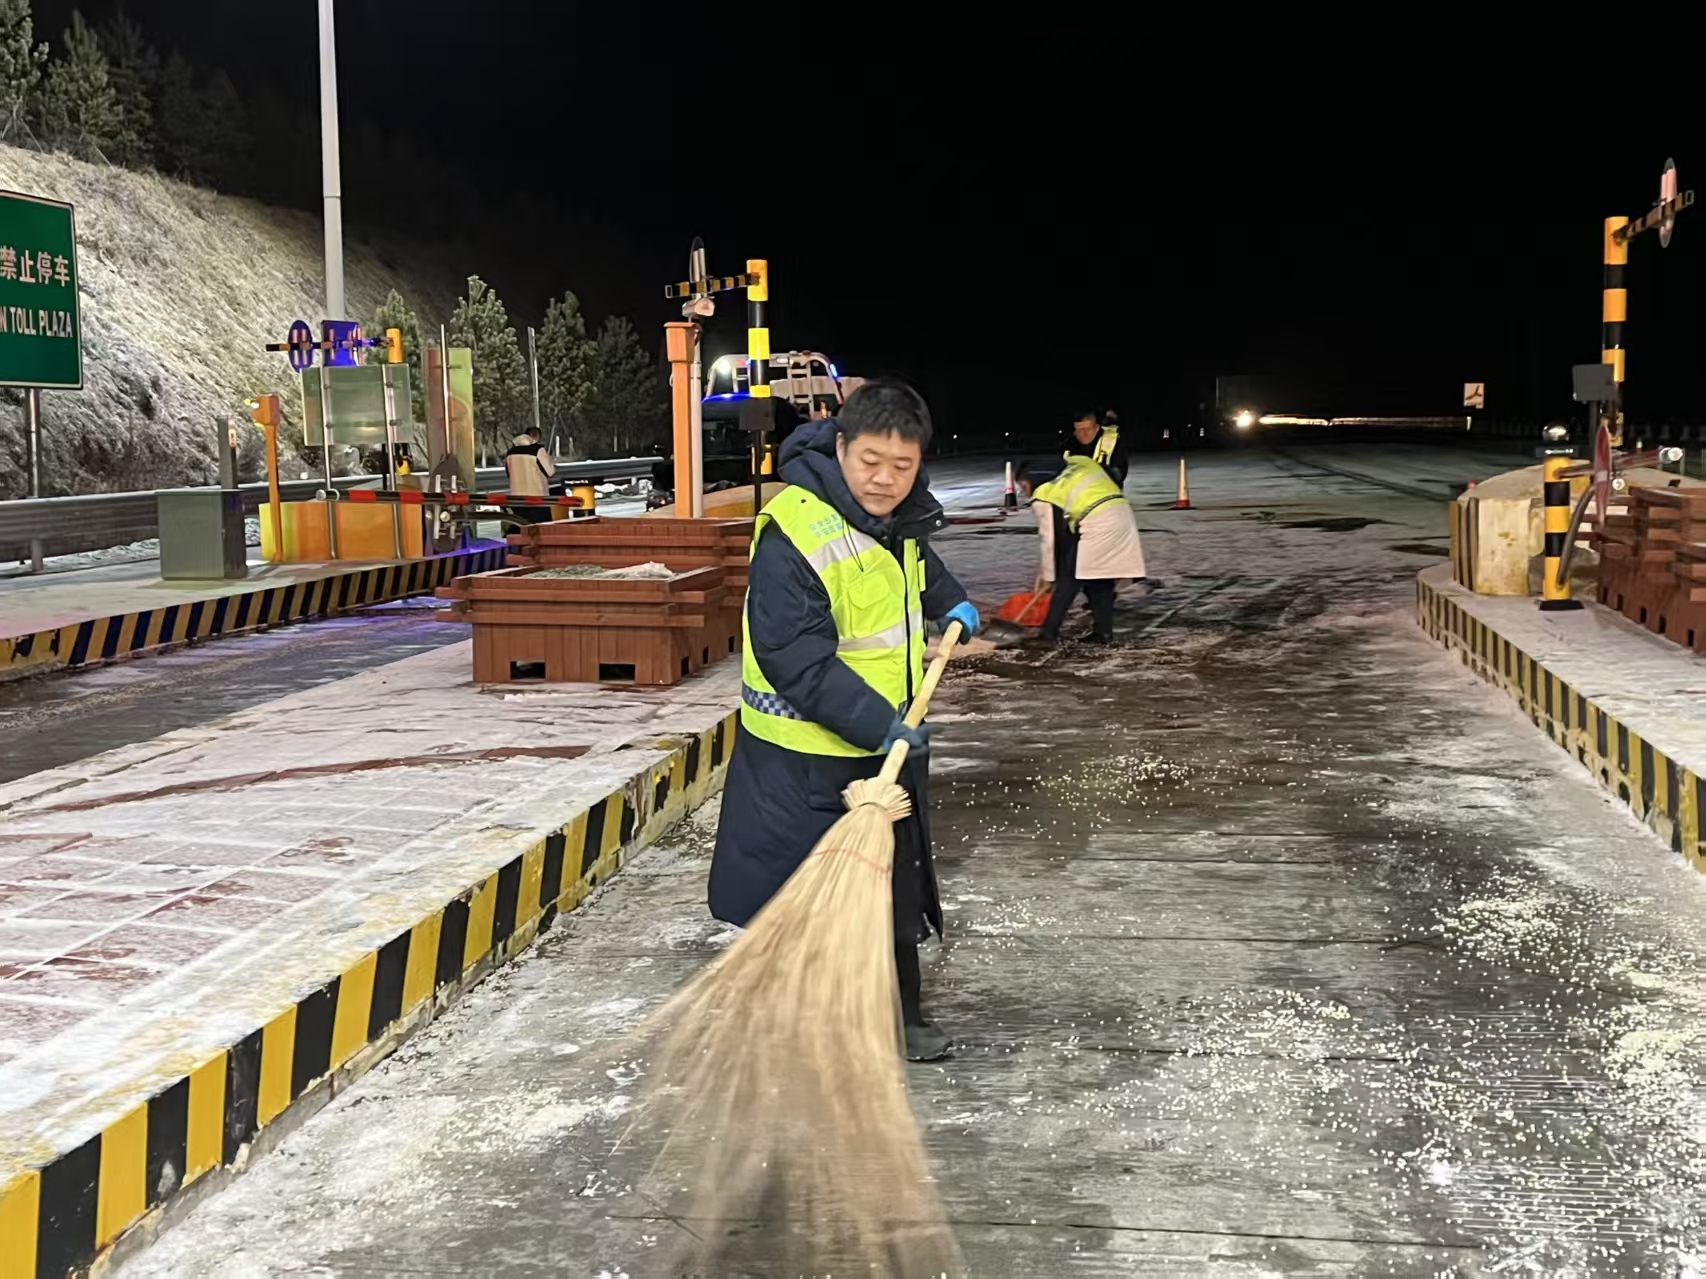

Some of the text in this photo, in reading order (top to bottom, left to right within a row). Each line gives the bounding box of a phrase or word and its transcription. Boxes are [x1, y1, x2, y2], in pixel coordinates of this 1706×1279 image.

[0, 245, 70, 287] 禁止停车
[9, 306, 37, 336] TOLL
[38, 309, 73, 338] PLAZA
